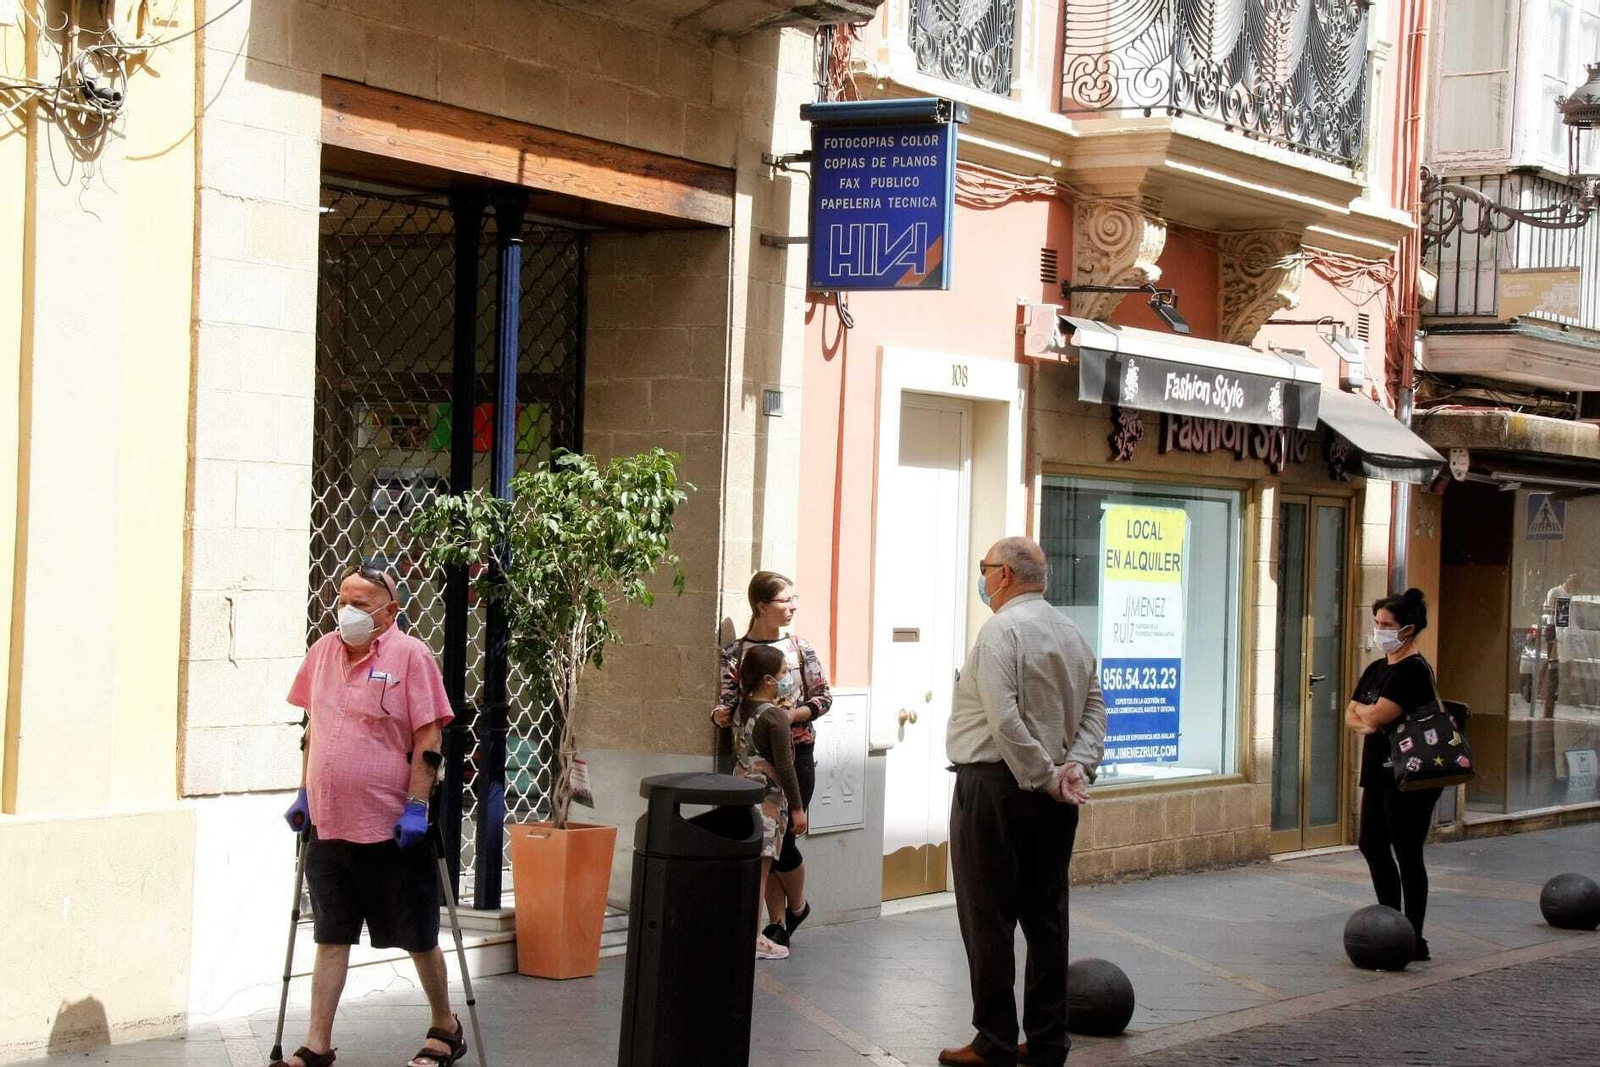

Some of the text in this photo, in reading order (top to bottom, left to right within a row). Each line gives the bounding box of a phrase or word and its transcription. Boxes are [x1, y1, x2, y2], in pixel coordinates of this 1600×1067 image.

[824, 135, 939, 149] FOTOCOPIAS COLOR
[824, 155, 938, 169] COPIAS DE PLANOS
[839, 176, 920, 189] FAX PUBLICO
[821, 196, 938, 209] PAPELERIA TECNICA
[829, 222, 928, 277] HIVA
[951, 364, 968, 388] 108
[1165, 372, 1245, 413] Fashion Style
[1126, 519, 1163, 540] LOCAL
[1106, 549, 1181, 572] EN ALQUILER
[1113, 621, 1135, 644] RUIZ
[1103, 667, 1176, 690] 956.54.23.23
[1103, 745, 1177, 760] WW.JIMENEZRUIZ.COM
